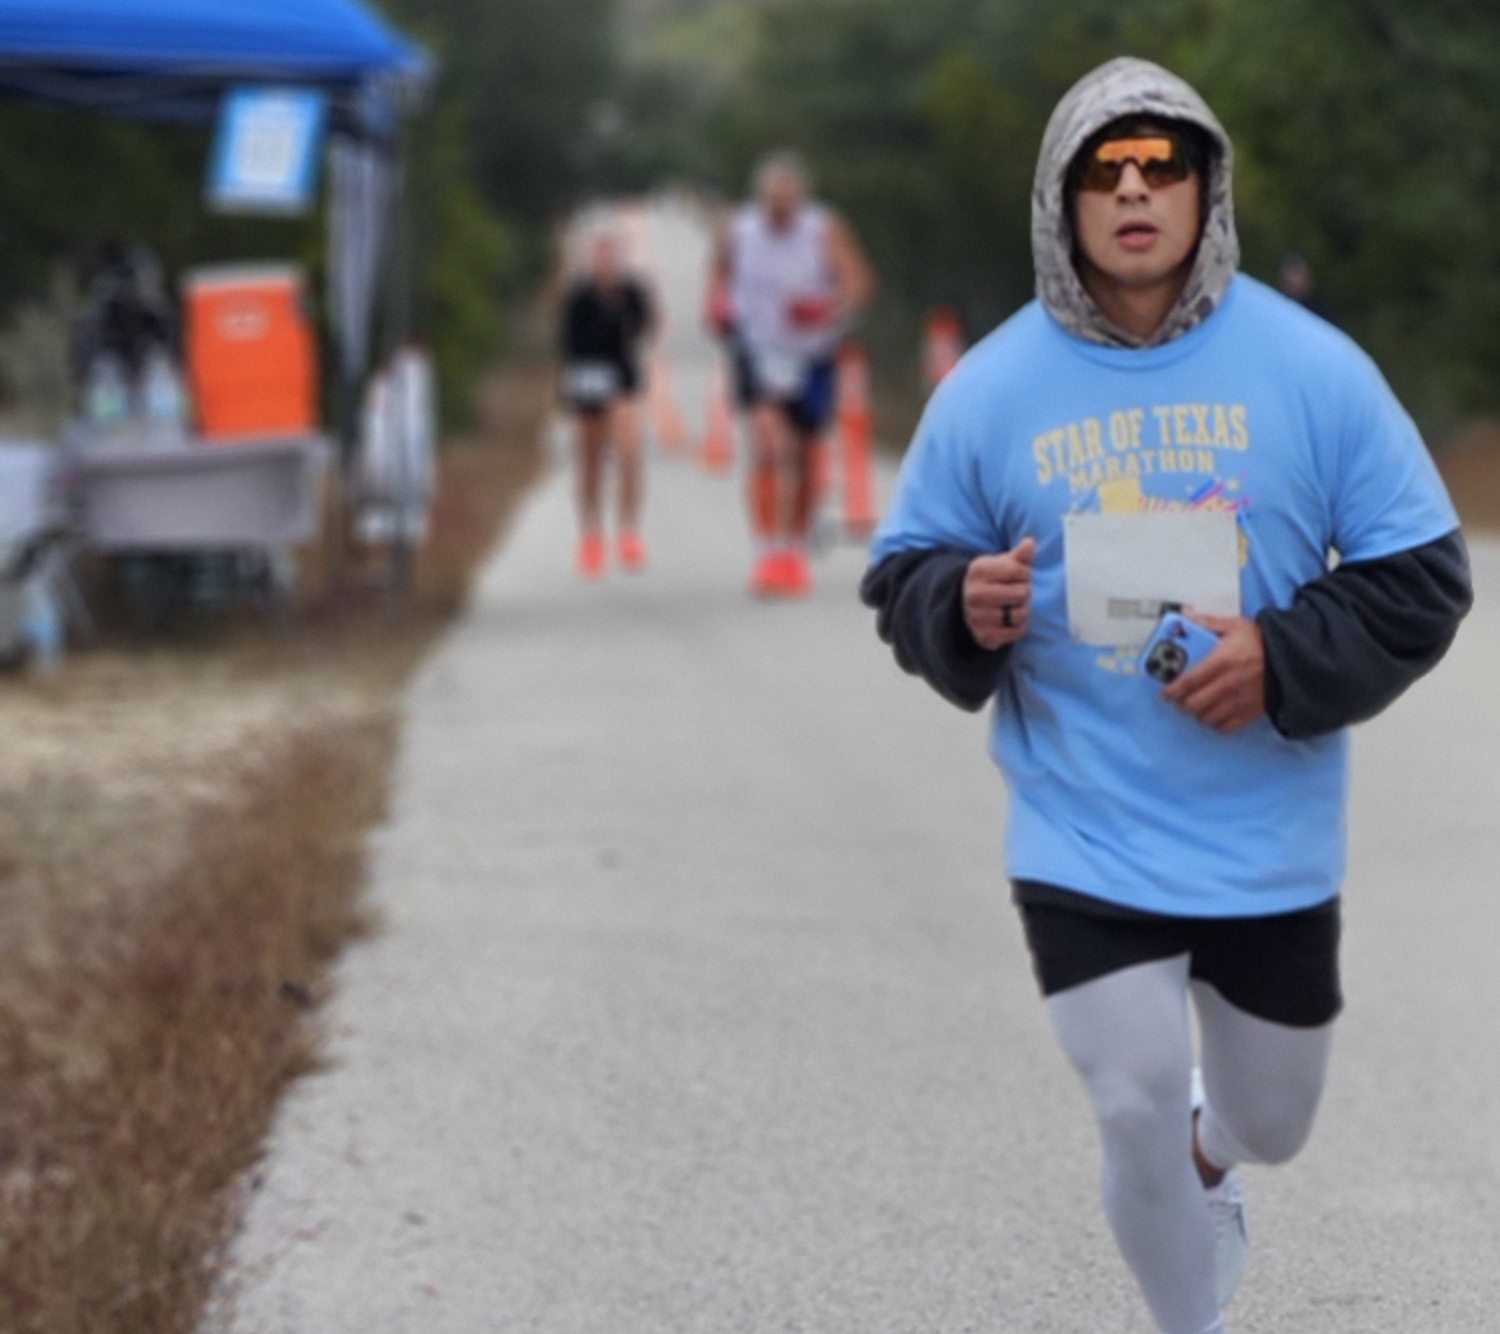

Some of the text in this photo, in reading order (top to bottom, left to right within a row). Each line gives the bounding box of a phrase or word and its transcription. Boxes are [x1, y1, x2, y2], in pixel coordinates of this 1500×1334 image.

[1034, 403, 1248, 484] STAR OF TEXAS
[1069, 447, 1214, 492] MARATHON
